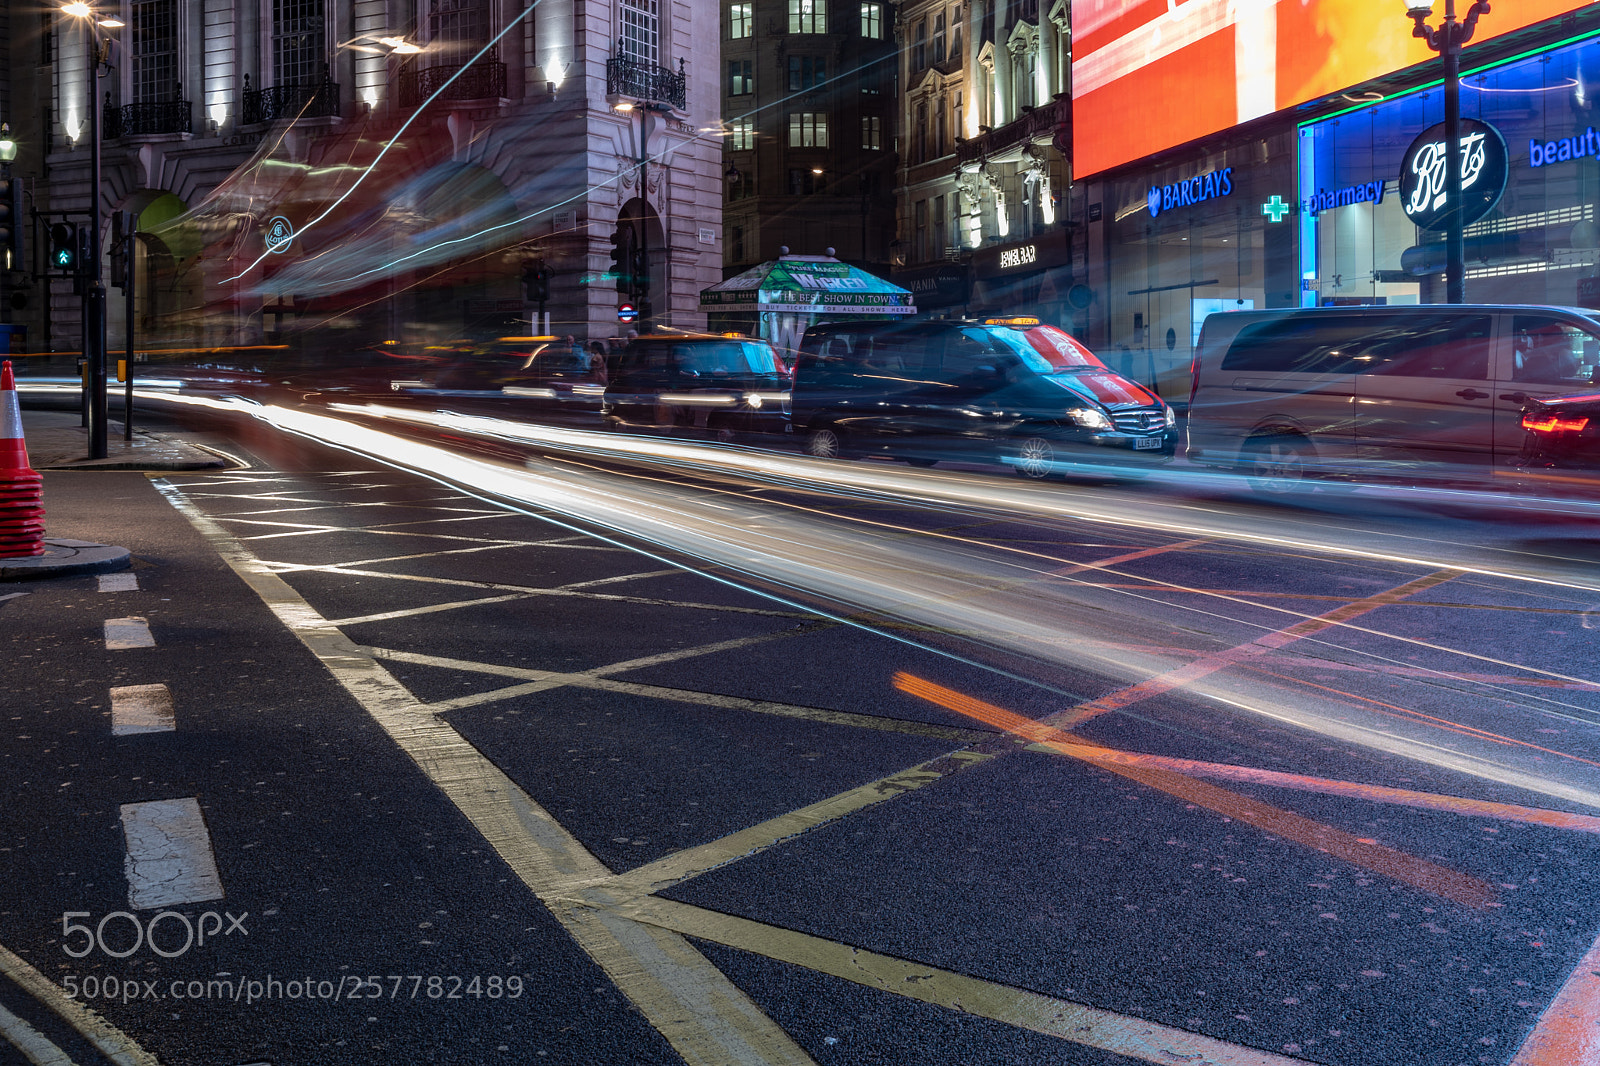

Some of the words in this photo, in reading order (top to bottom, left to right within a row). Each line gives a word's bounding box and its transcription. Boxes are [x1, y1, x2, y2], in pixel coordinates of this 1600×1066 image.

[1163, 167, 1232, 211] BARCLAYS
[1405, 131, 1486, 215] Bots
[1309, 179, 1384, 218] pharmacy
[1000, 248, 1021, 269] JEWEL
[1019, 244, 1037, 265] BAR
[799, 293, 822, 303] BEST
[824, 293, 853, 304] SHOW
[854, 294, 866, 304] IN
